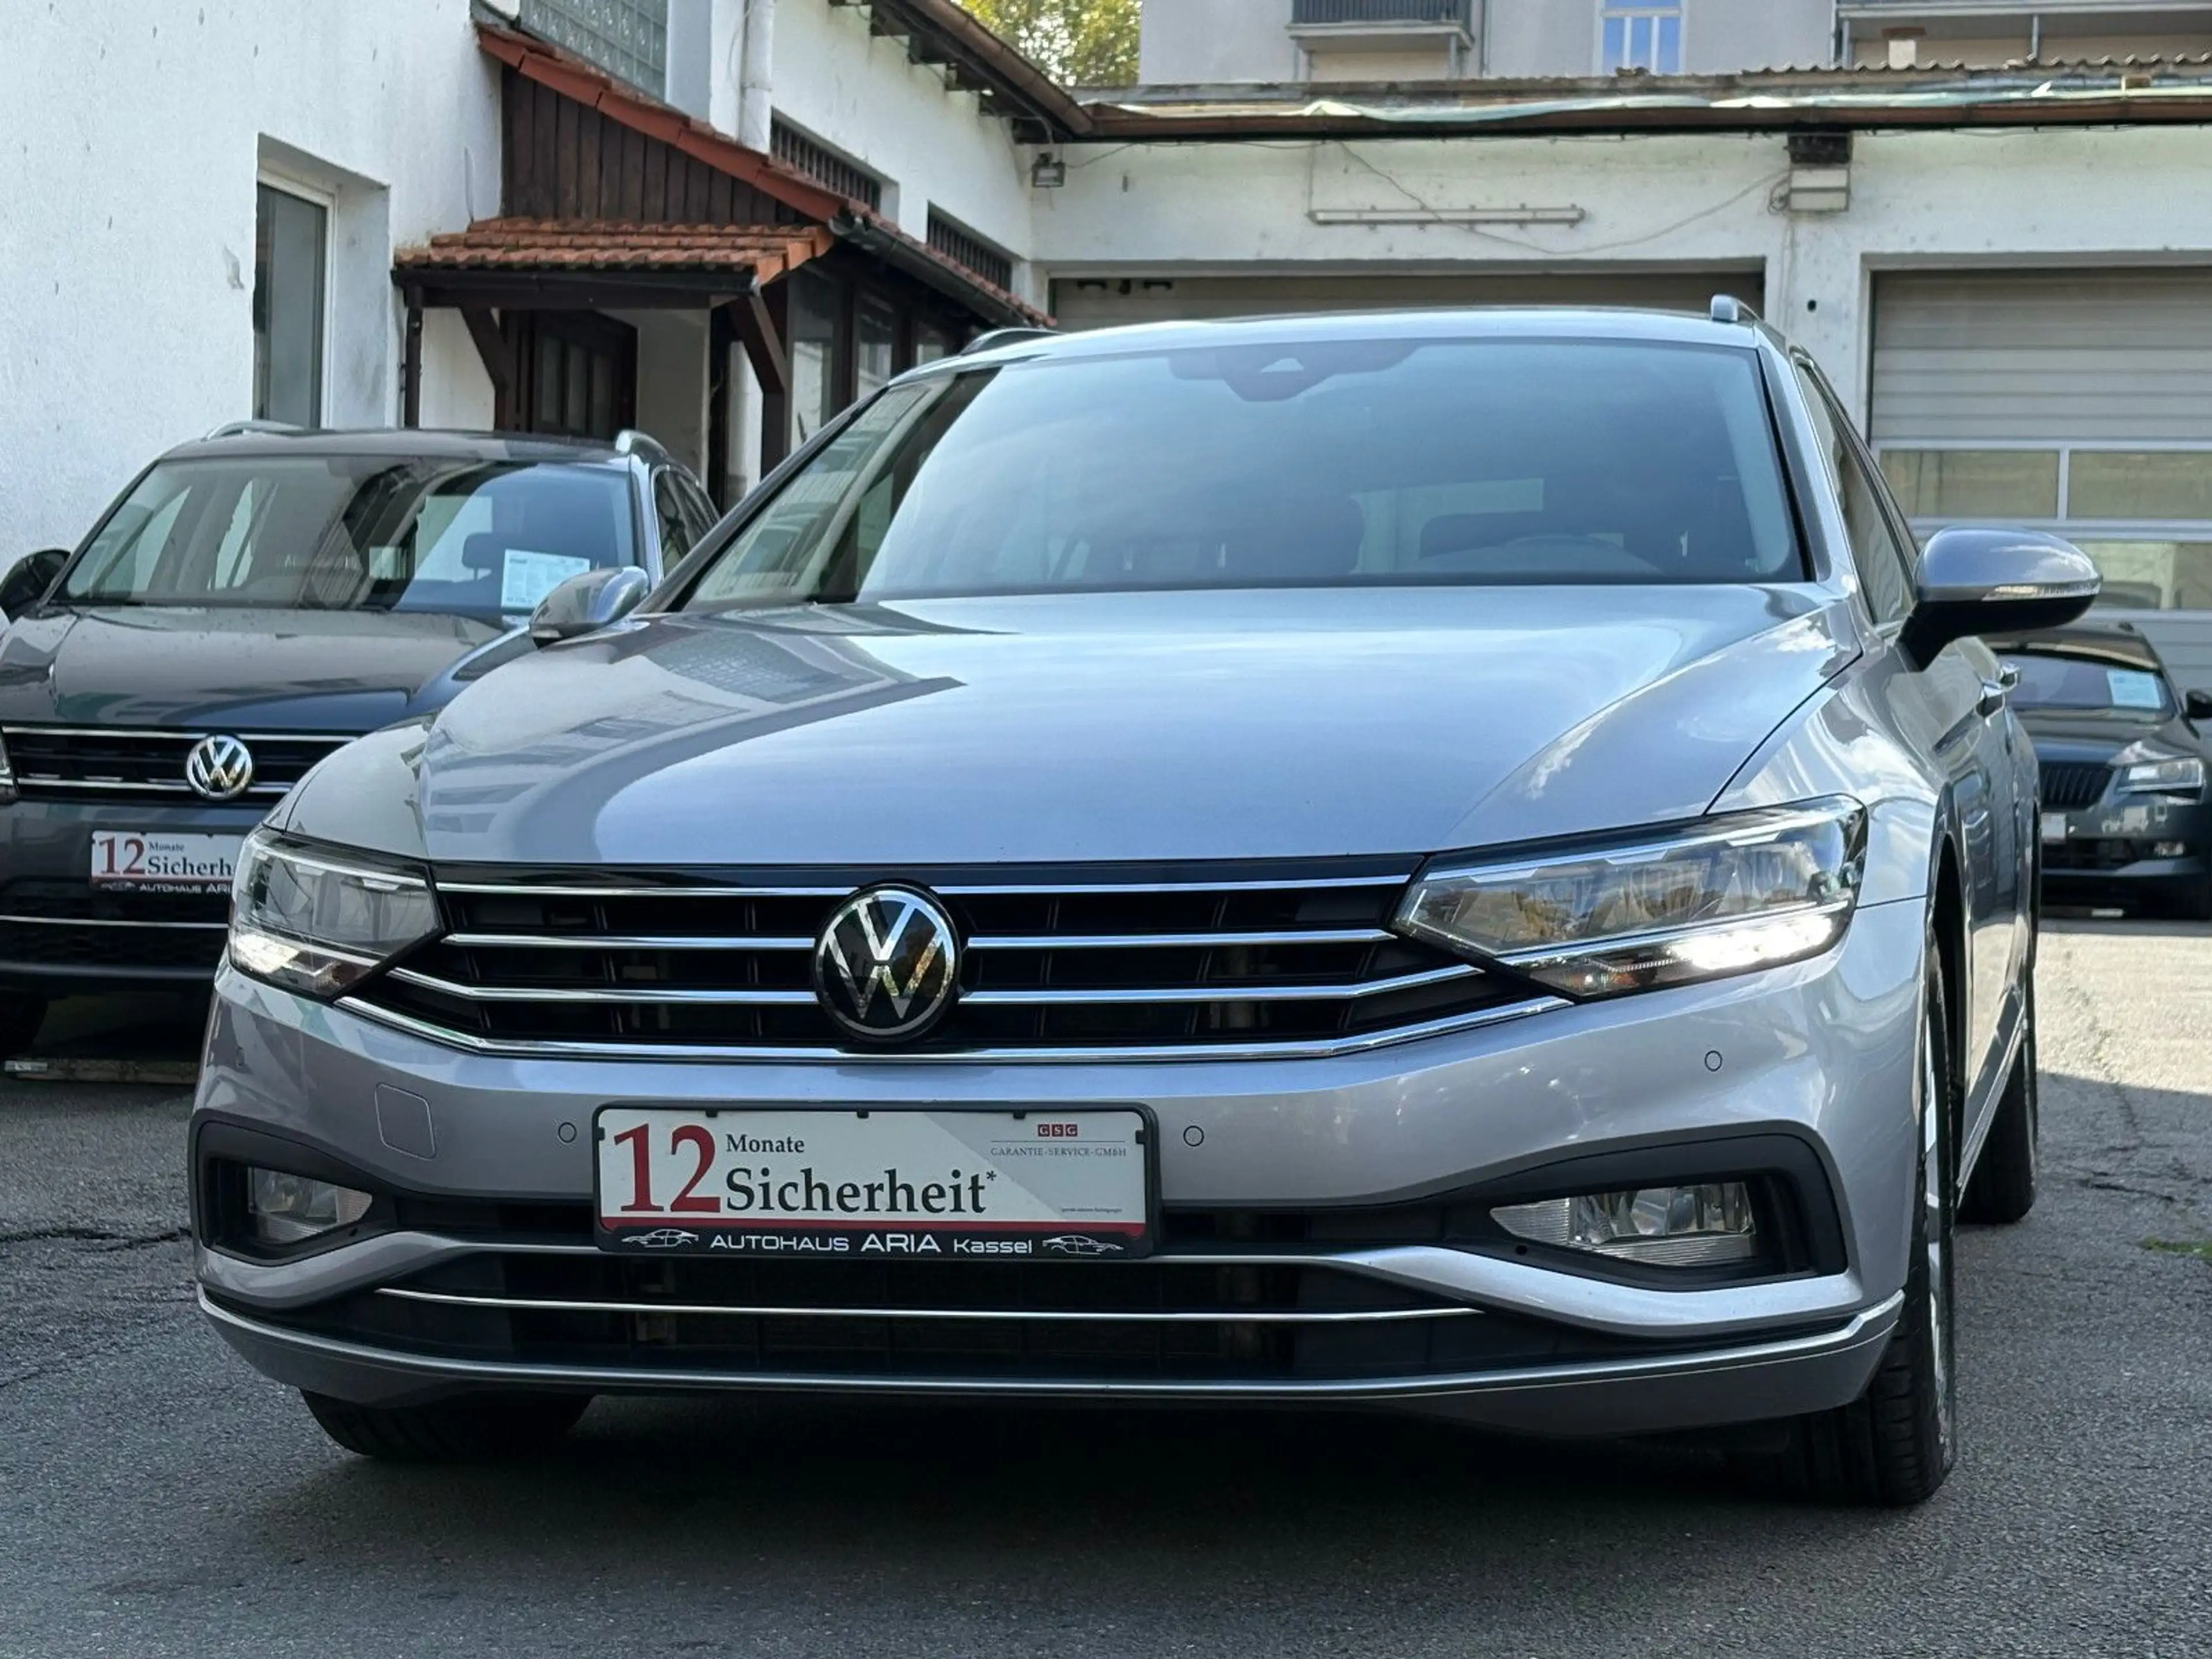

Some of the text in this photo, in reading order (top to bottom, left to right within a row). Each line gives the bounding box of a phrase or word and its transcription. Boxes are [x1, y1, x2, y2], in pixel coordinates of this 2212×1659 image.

[188, 736, 252, 797] VW
[99, 836, 146, 874] 12
[147, 855, 236, 876] Sicherh
[206, 883, 231, 895] ARI
[820, 892, 952, 1027] VW
[1037, 1124, 1078, 1137] GSG
[726, 1134, 805, 1153] Monate
[613, 1123, 721, 1213] 12
[710, 1233, 1032, 1254] AUTOHAUS ARIA Kassel
